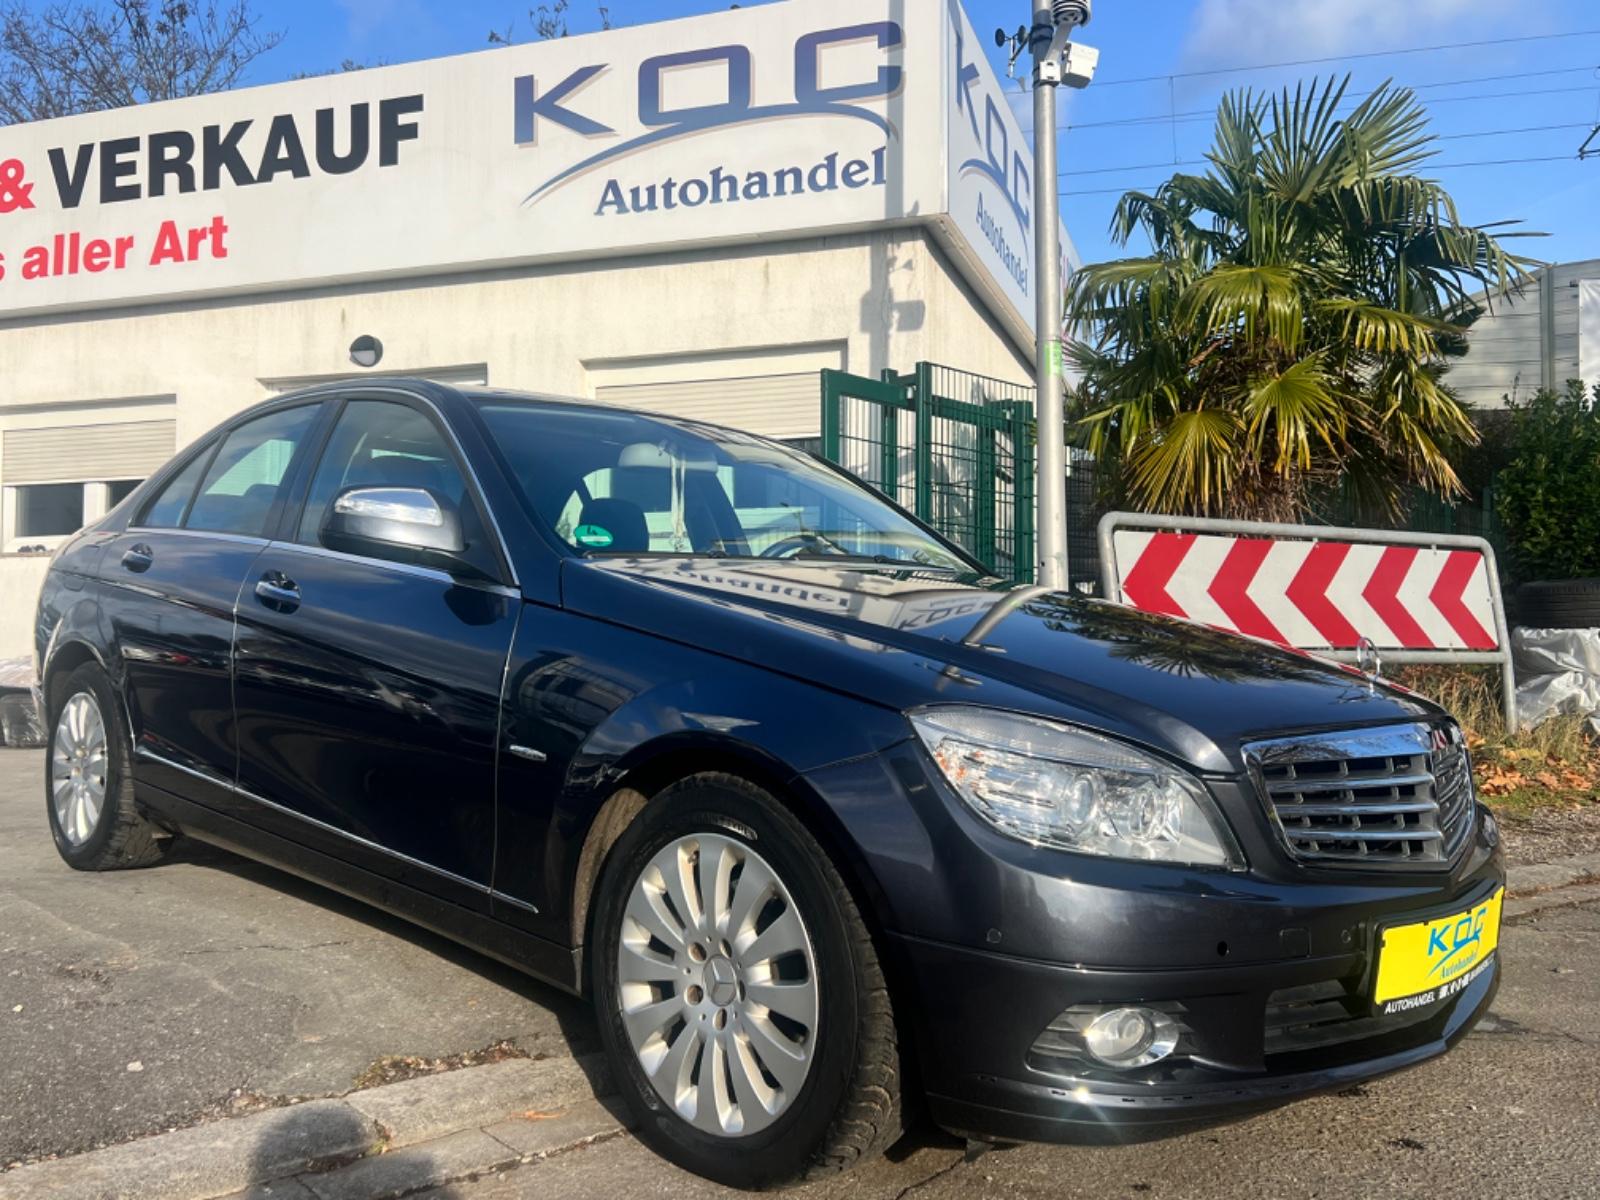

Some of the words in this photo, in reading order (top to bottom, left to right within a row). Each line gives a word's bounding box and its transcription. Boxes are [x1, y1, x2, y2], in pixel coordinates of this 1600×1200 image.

[514, 21, 903, 145] KOC
[0, 159, 36, 213] &
[48, 94, 424, 209] VERKAUF
[594, 146, 886, 216] Autohandel
[22, 232, 134, 280] aller
[149, 216, 228, 265] Art
[975, 192, 1029, 298] Autohandel
[1384, 991, 1436, 1015] AUTOHANDEL
